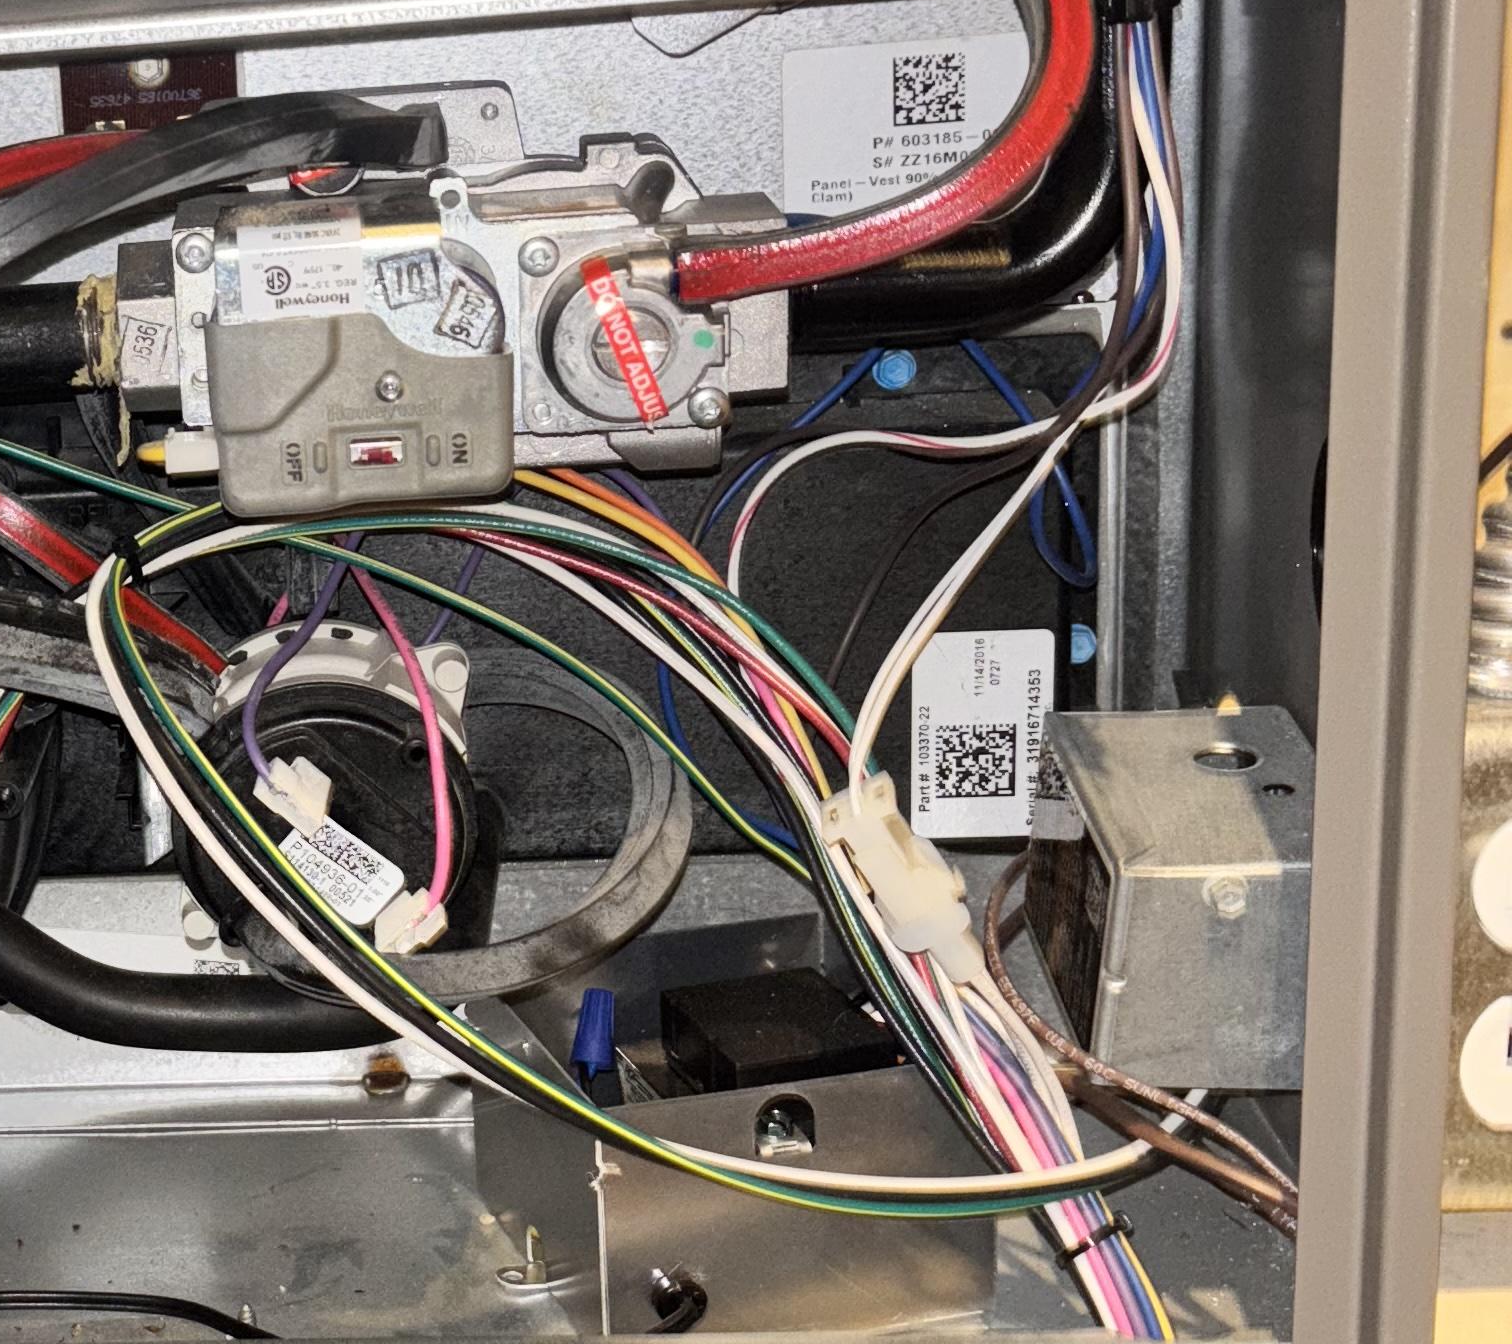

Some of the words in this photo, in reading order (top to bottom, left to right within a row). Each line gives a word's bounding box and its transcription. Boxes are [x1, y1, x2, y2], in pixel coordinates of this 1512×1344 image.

[901, 131, 963, 147] 603185
[811, 179, 852, 191] Panel
[275, 292, 351, 310] Honeywell
[606, 311, 638, 357] NOT
[285, 442, 303, 482] OFF
[450, 432, 468, 464] ON
[974, 638, 984, 697] 11/14/2016
[990, 660, 1000, 686] 0727
[1027, 669, 1041, 763] 31916714353
[919, 706, 930, 766] 103370-22
[919, 773, 930, 782] #
[919, 783, 930, 812] Part
